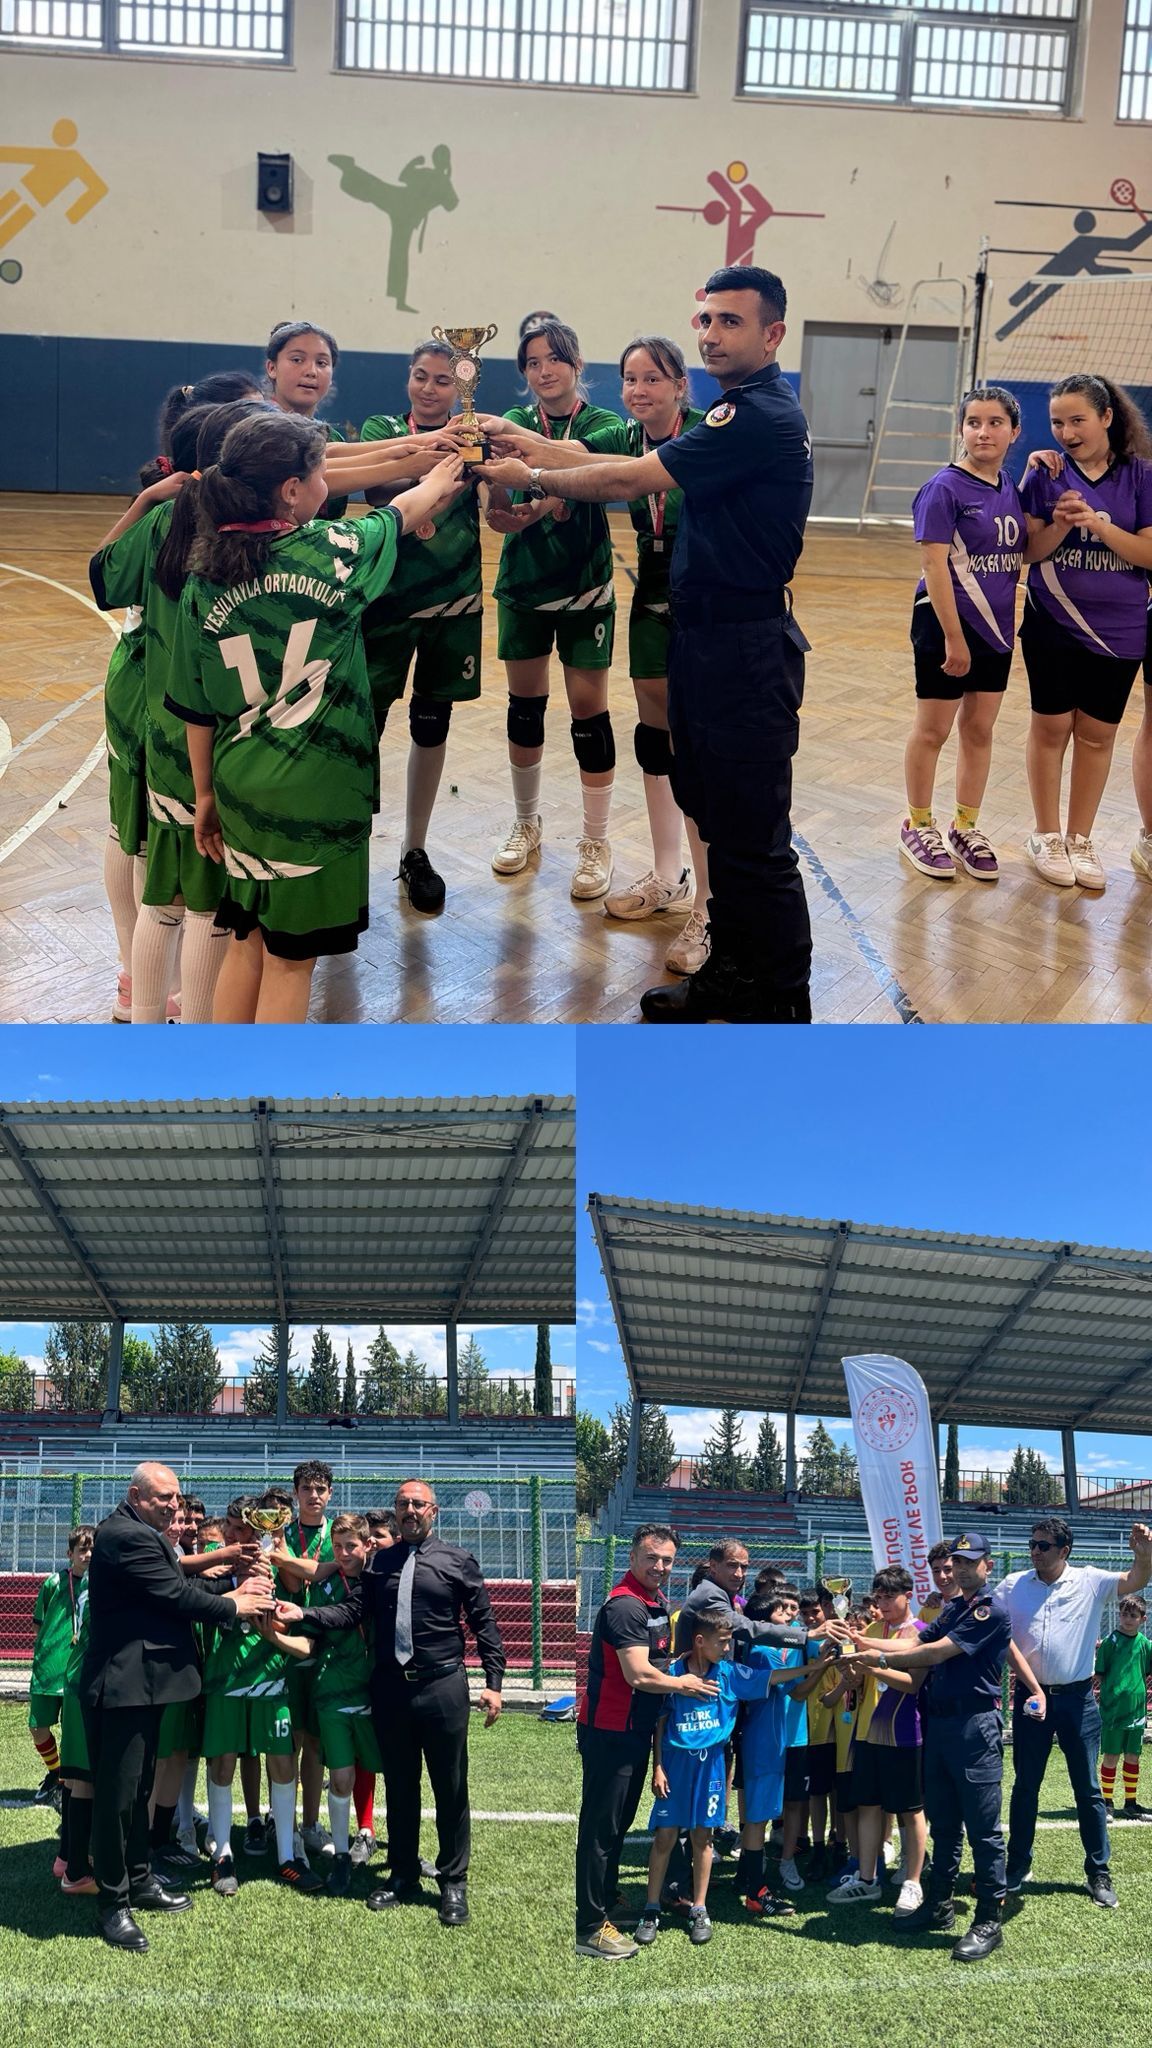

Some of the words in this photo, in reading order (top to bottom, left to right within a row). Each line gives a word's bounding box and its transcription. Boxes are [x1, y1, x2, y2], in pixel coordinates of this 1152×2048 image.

[994, 515, 1019, 547] 10
[967, 554, 999, 578] KOÇER
[1052, 547, 1082, 571] OÇER
[203, 577, 262, 634] YEŞİLYAYLA
[264, 573, 340, 608] ORTAOKULU
[594, 623, 606, 648] 9
[462, 655, 475, 680] 3
[217, 618, 332, 742] 16
[274, 1718, 290, 1738] 15
[676, 1718, 721, 1733] TELEKOM
[707, 1794, 720, 1818] 8
